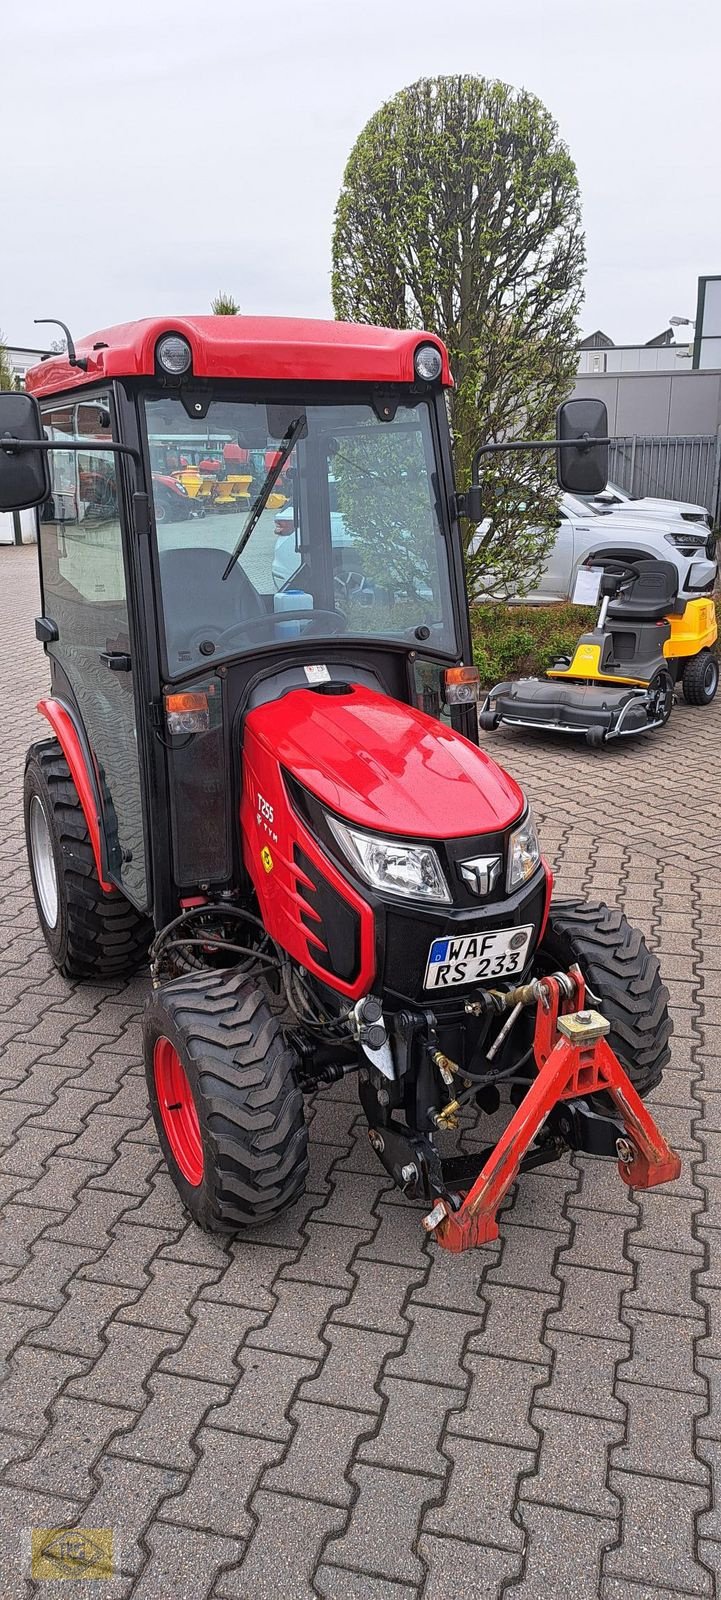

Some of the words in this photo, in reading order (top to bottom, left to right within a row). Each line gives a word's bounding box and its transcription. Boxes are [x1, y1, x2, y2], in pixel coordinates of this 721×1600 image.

[257, 792, 274, 823] T255
[263, 822, 278, 844] TYM
[435, 954, 442, 962] D
[449, 935, 497, 961] WAF
[435, 963, 467, 985] RS
[476, 952, 520, 977] 233
